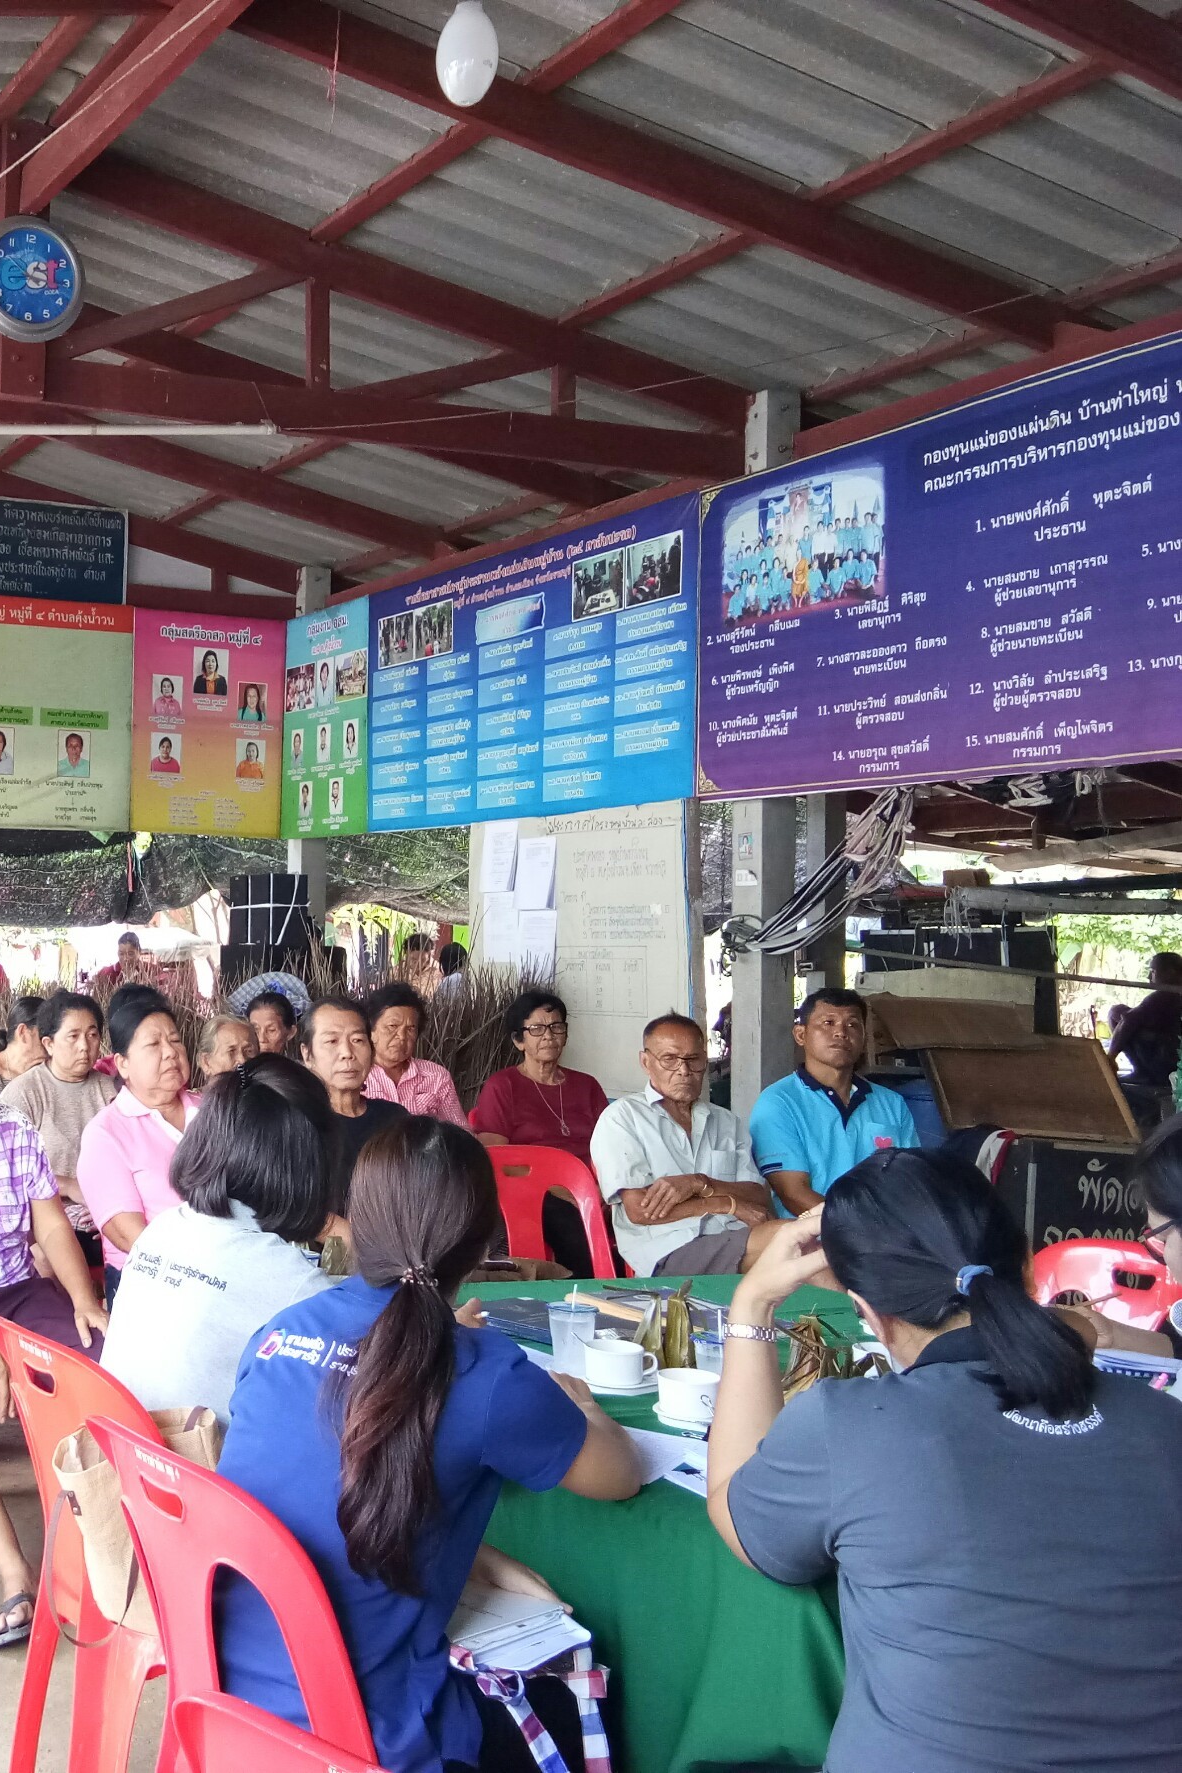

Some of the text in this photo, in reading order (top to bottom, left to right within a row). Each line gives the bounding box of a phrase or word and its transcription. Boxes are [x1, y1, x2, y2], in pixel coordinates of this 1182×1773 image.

[9, 238, 15, 247] 11
[26, 234, 36, 244] 12
[47, 244, 51, 253] 1
[59, 259, 67, 269] 2
[1, 259, 59, 290] est
[63, 279, 70, 288] 3
[6, 303, 13, 312] 7
[55, 297, 63, 306] 4
[24, 312, 32, 321] 6
[43, 309, 50, 318] 5
[923, 378, 1168, 466] กองทุนแม่ของแผ่นดิน บ้านท่าใหญ่
[924, 411, 1181, 493] คณะกรรมการบริหารกองทุนแม่ของ
[975, 473, 1152, 533] 1. นายพงศ์ศักดิ์ หุตะจิตต์
[1034, 520, 1087, 542] ประธาน
[1141, 538, 1182, 557] 5. นาง
[965, 581, 976, 593] 4.
[983, 567, 1040, 588] นายสมชาย
[994, 577, 1077, 608] ผู้ช่วยเลขานุการ
[1146, 599, 1157, 610] 9.
[9, 603, 33, 625] หมู่ที่
[35, 610, 45, 621] ๔
[48, 607, 115, 628] ตำบลคุ้งน้ำวน
[834, 609, 843, 620] 3.
[857, 613, 902, 631] เลขานุการ
[981, 606, 1093, 639] 8. นายสมชาย สวัสดี
[160, 625, 262, 648] กลุ่มสตรีอาสา หมู่ที่ ๔
[706, 636, 714, 646] 2.
[990, 627, 1083, 658] ผู้ช่วยนายทะเบียน
[730, 638, 775, 655] รองประธาน
[816, 657, 825, 668] 7.
[828, 642, 908, 666] นางสาวละอองดาว
[853, 657, 907, 677] นายทะเบียน
[1127, 659, 1146, 673] 13.
[711, 676, 719, 687] 6.
[969, 663, 1108, 695] 12. นางวิลัย ลำประเสริฐ
[725, 679, 779, 701] ผู้ช่วยเหรัญญิก
[992, 686, 1081, 712] ผู้ช่วยผู้ตรวจสอบ
[817, 683, 948, 717] 11. นายประวิทย์ สอนส่งกลิ่น
[708, 721, 720, 732] 10.
[855, 711, 905, 730] ผู้ตรวจสอบ
[716, 723, 789, 748] ผู้ช่วยประชาสัมพันธ์
[965, 719, 1114, 748] 15. นายสมศักดิ์ เพ็ญไพจิตร
[832, 751, 845, 762] 14.
[848, 743, 887, 761] นายอรุณ
[1012, 744, 1061, 759] กรรมการ
[859, 761, 900, 774] กรรมการ
